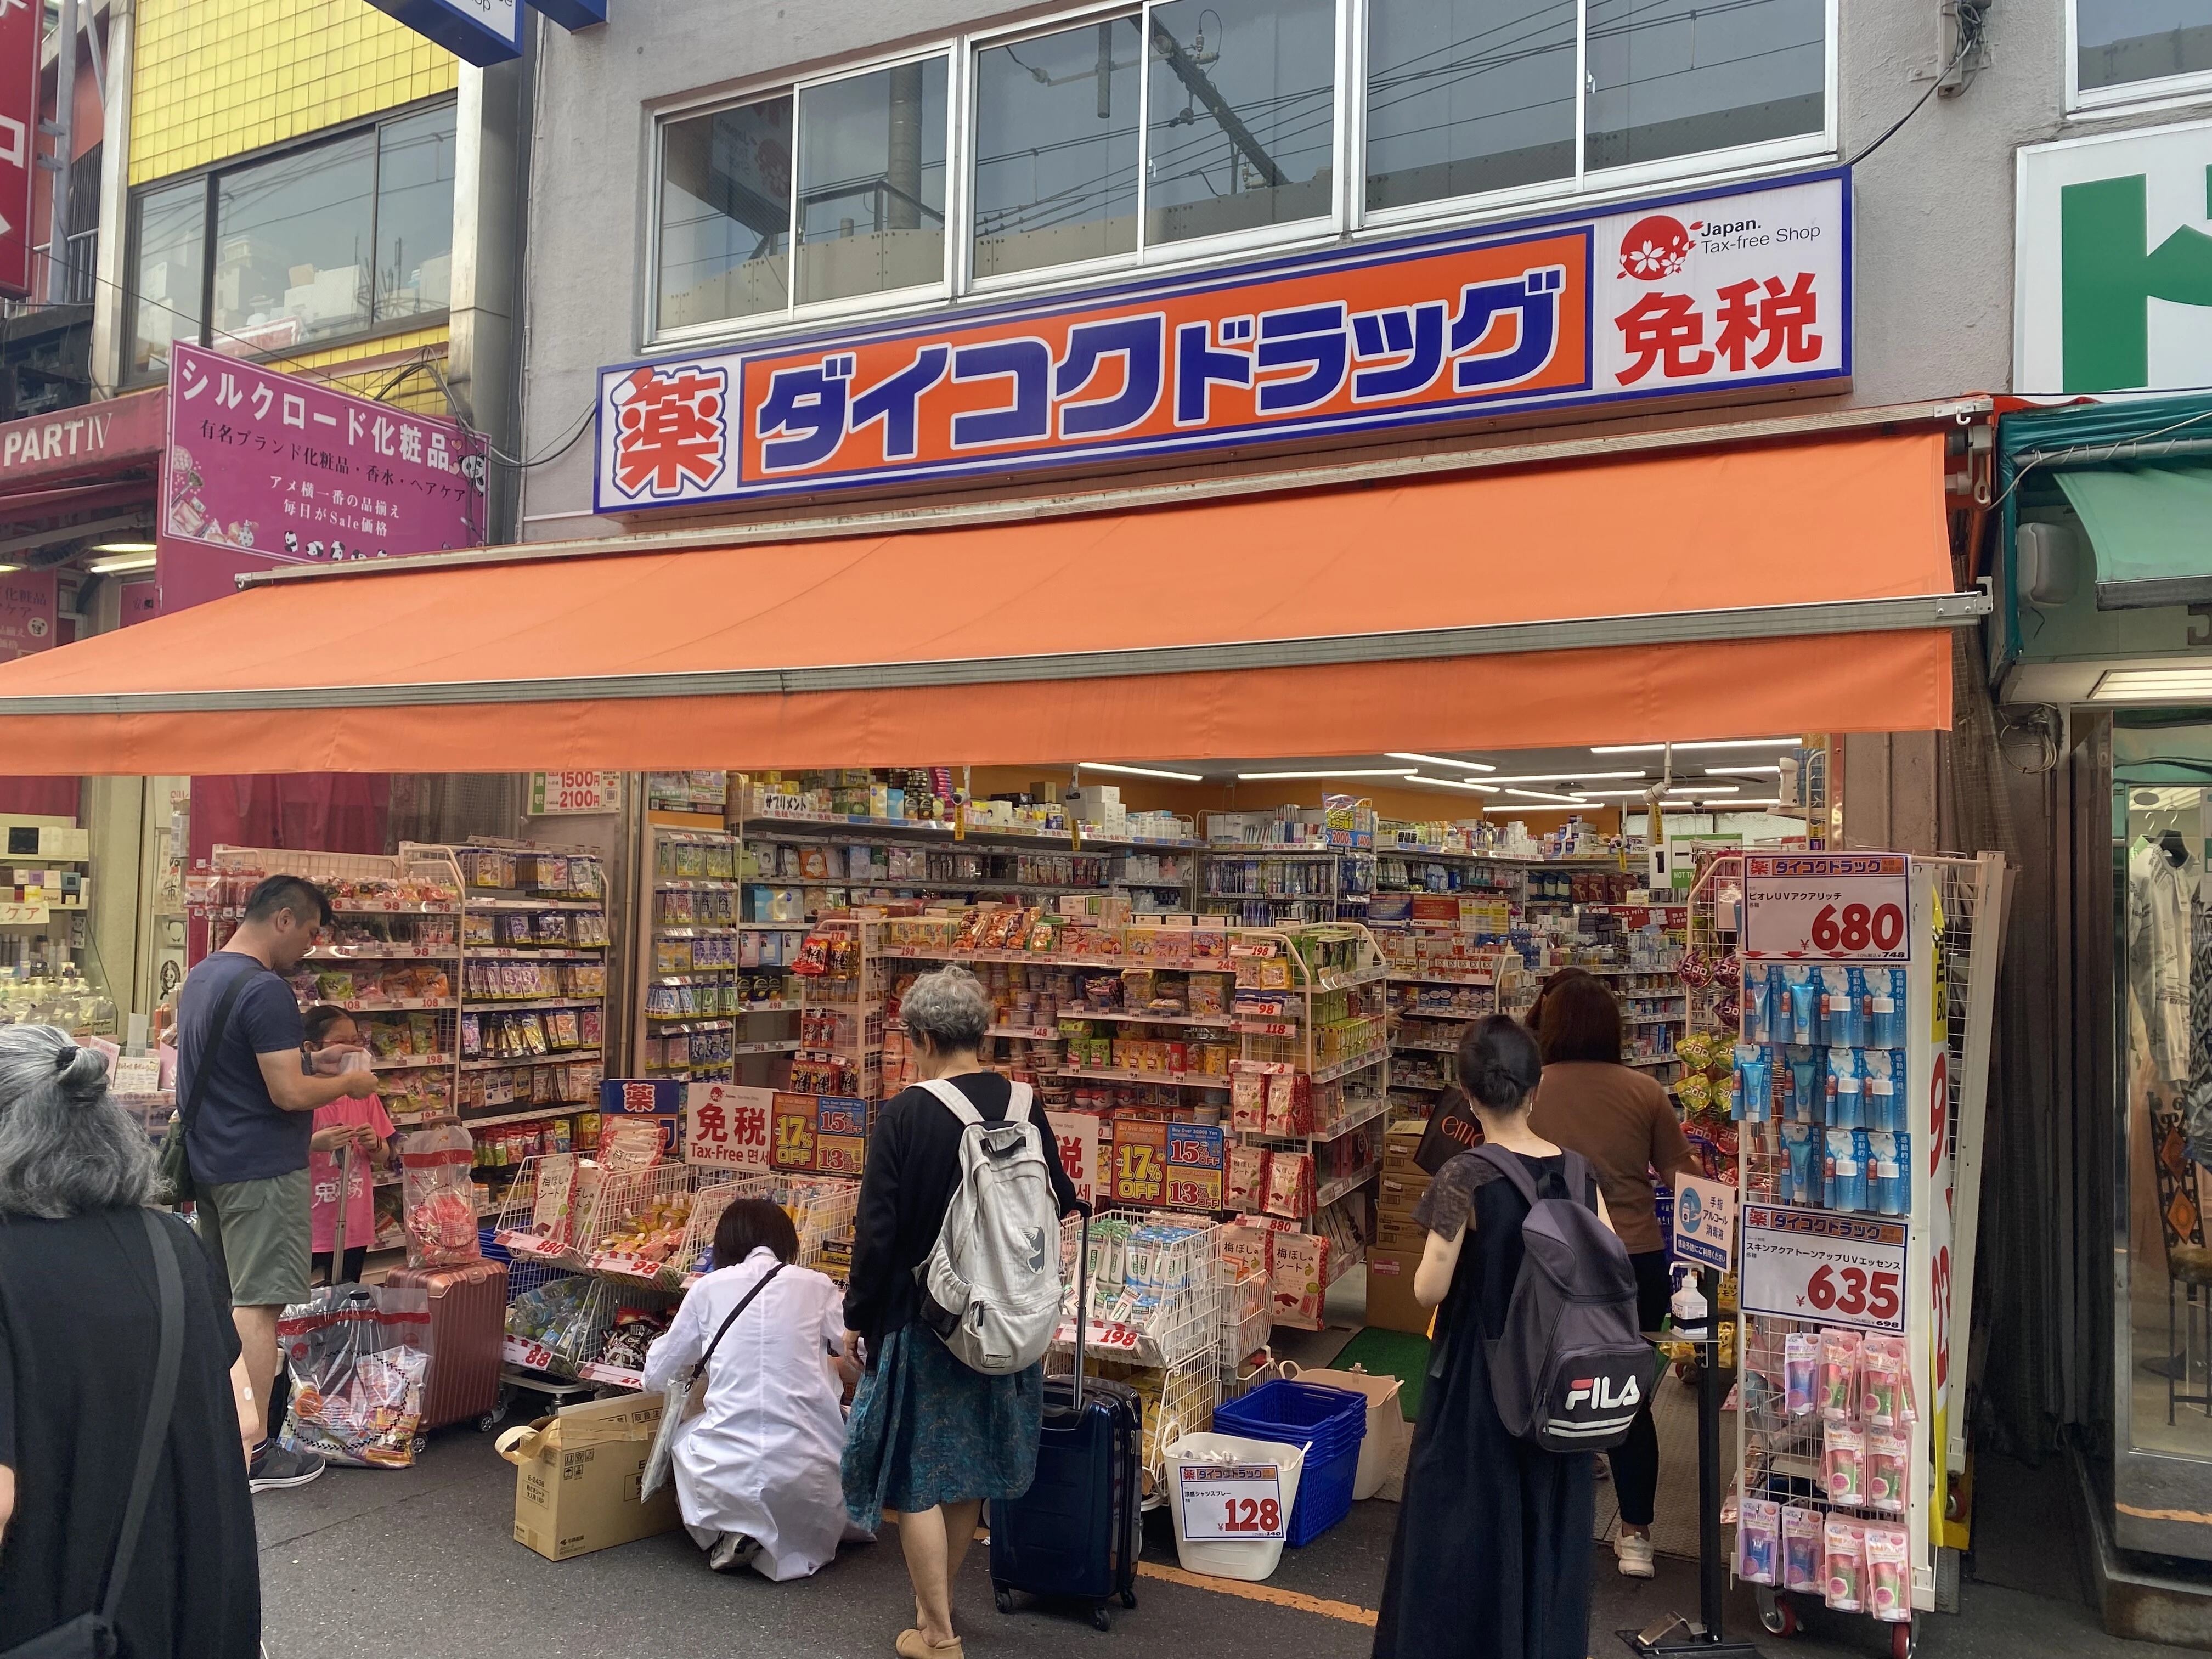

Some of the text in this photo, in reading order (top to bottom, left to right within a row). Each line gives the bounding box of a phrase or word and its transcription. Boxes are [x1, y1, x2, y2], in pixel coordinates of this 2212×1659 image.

[1700, 218, 1762, 238] Japan.
[1703, 224, 1820, 254] Tax-free Shop
[1615, 272, 1822, 386] 免税
[756, 264, 1565, 474] ダイコクドラッグ
[182, 359, 449, 472] シルクロード化粧品
[614, 366, 724, 491] 薬
[270, 475, 399, 518] アメ横一番の品揃え
[559, 789, 600, 808] 2100円
[1750, 858, 1769, 875] 薬
[1775, 859, 1881, 874] ダイコクドラッグ
[384, 901, 400, 911] 98
[438, 903, 450, 912] 98
[831, 932, 845, 940] 178
[413, 947, 429, 956] 98
[901, 947, 915, 956] 198
[1252, 946, 1269, 956] 198
[1217, 961, 1237, 970] 248
[343, 1001, 360, 1010] 108
[422, 998, 438, 1007] 108
[1259, 1005, 1274, 1014] 98
[1034, 1028, 1048, 1037] 148
[1265, 1024, 1286, 1034] 118
[426, 1055, 442, 1064] 198
[625, 1081, 653, 1111] 薬
[696, 1103, 766, 1146] 免税
[844, 1126, 862, 1134] OFF
[690, 1142, 743, 1162] Tax-Free
[776, 1147, 811, 1165] OFF
[843, 1163, 861, 1172] OFF
[1198, 1156, 1221, 1166] OFF
[542, 1177, 569, 1188] 梅ぼしの
[1119, 1180, 1160, 1200] OFF
[1197, 1198, 1220, 1208] OFF
[1709, 1196, 1723, 1211] 手指
[1703, 1209, 1728, 1226] アルコール
[1269, 1220, 1291, 1232] 880
[1706, 1224, 1724, 1241] 消毒液
[1774, 1213, 1881, 1240] ダイコクドラッグ
[535, 1240, 566, 1255] 880
[1224, 1242, 1259, 1254] 梅ぼしの
[1277, 1247, 1314, 1262] 梅ぼしの
[1677, 1238, 1726, 1263] 感染予防にご利用ください
[1746, 1242, 1900, 1271] スキンアクアトーンアップUVエッセンス
[631, 1261, 661, 1275] 98
[1276, 1261, 1302, 1273] シート
[1099, 1329, 1138, 1346] 198
[525, 1350, 552, 1367] 88
[1565, 1375, 1640, 1410] FILA
